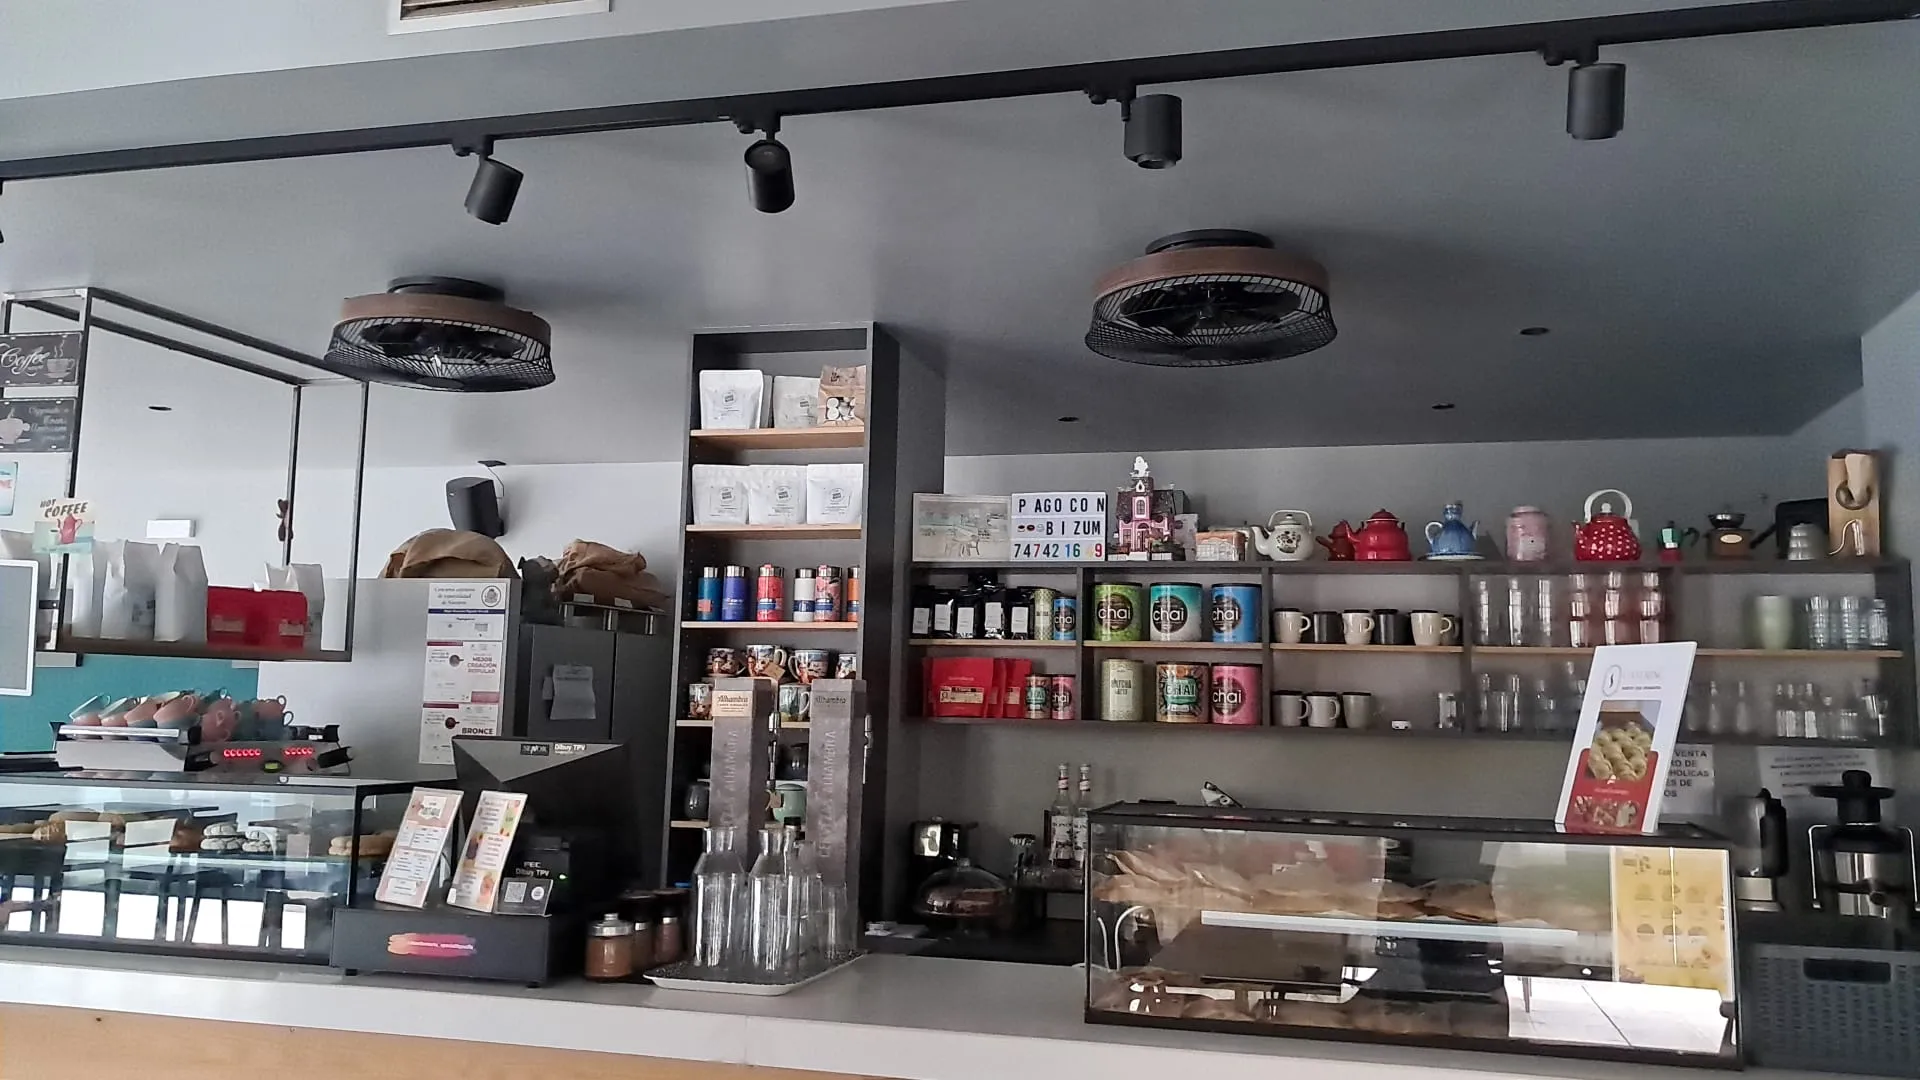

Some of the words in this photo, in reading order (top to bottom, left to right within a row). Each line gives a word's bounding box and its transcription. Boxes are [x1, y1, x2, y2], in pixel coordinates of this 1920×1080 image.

[40, 498, 57, 508] HOT
[44, 501, 88, 518] COFFEE
[1045, 520, 1101, 536] BIZUM
[1098, 605, 1131, 619] chai
[1153, 606, 1184, 621] chai
[1212, 607, 1239, 621] chai
[1165, 683, 1196, 697] CHAI
[1213, 690, 1242, 704] chai
[461, 727, 494, 735] BRONCE
[1674, 750, 1708, 758] VENTA
[1684, 760, 1697, 768] DE
[1680, 779, 1693, 787] DE
